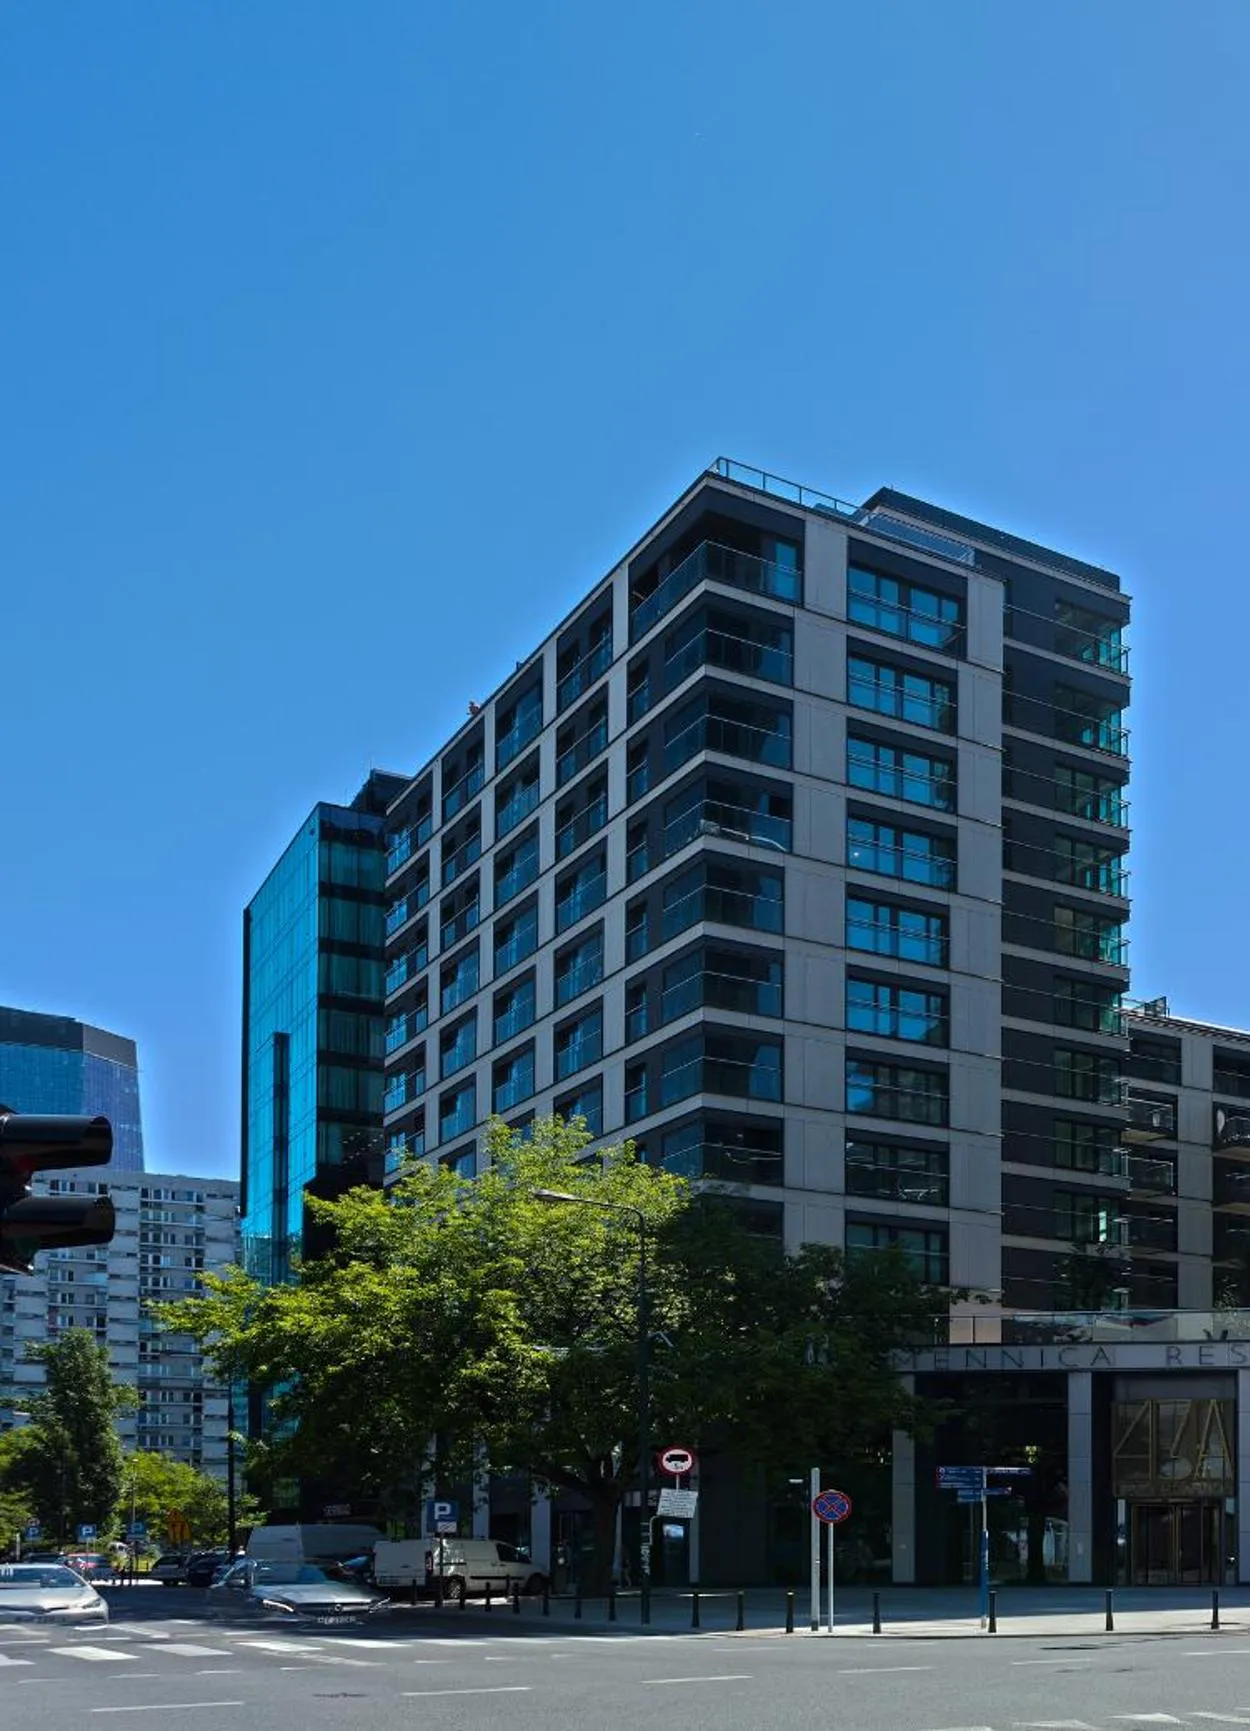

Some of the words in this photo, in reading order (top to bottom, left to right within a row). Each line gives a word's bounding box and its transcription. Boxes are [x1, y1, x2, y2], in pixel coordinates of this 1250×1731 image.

[892, 1346, 1111, 1370] MENNICA
[434, 1502, 451, 1519] P
[82, 1526, 93, 1536] P
